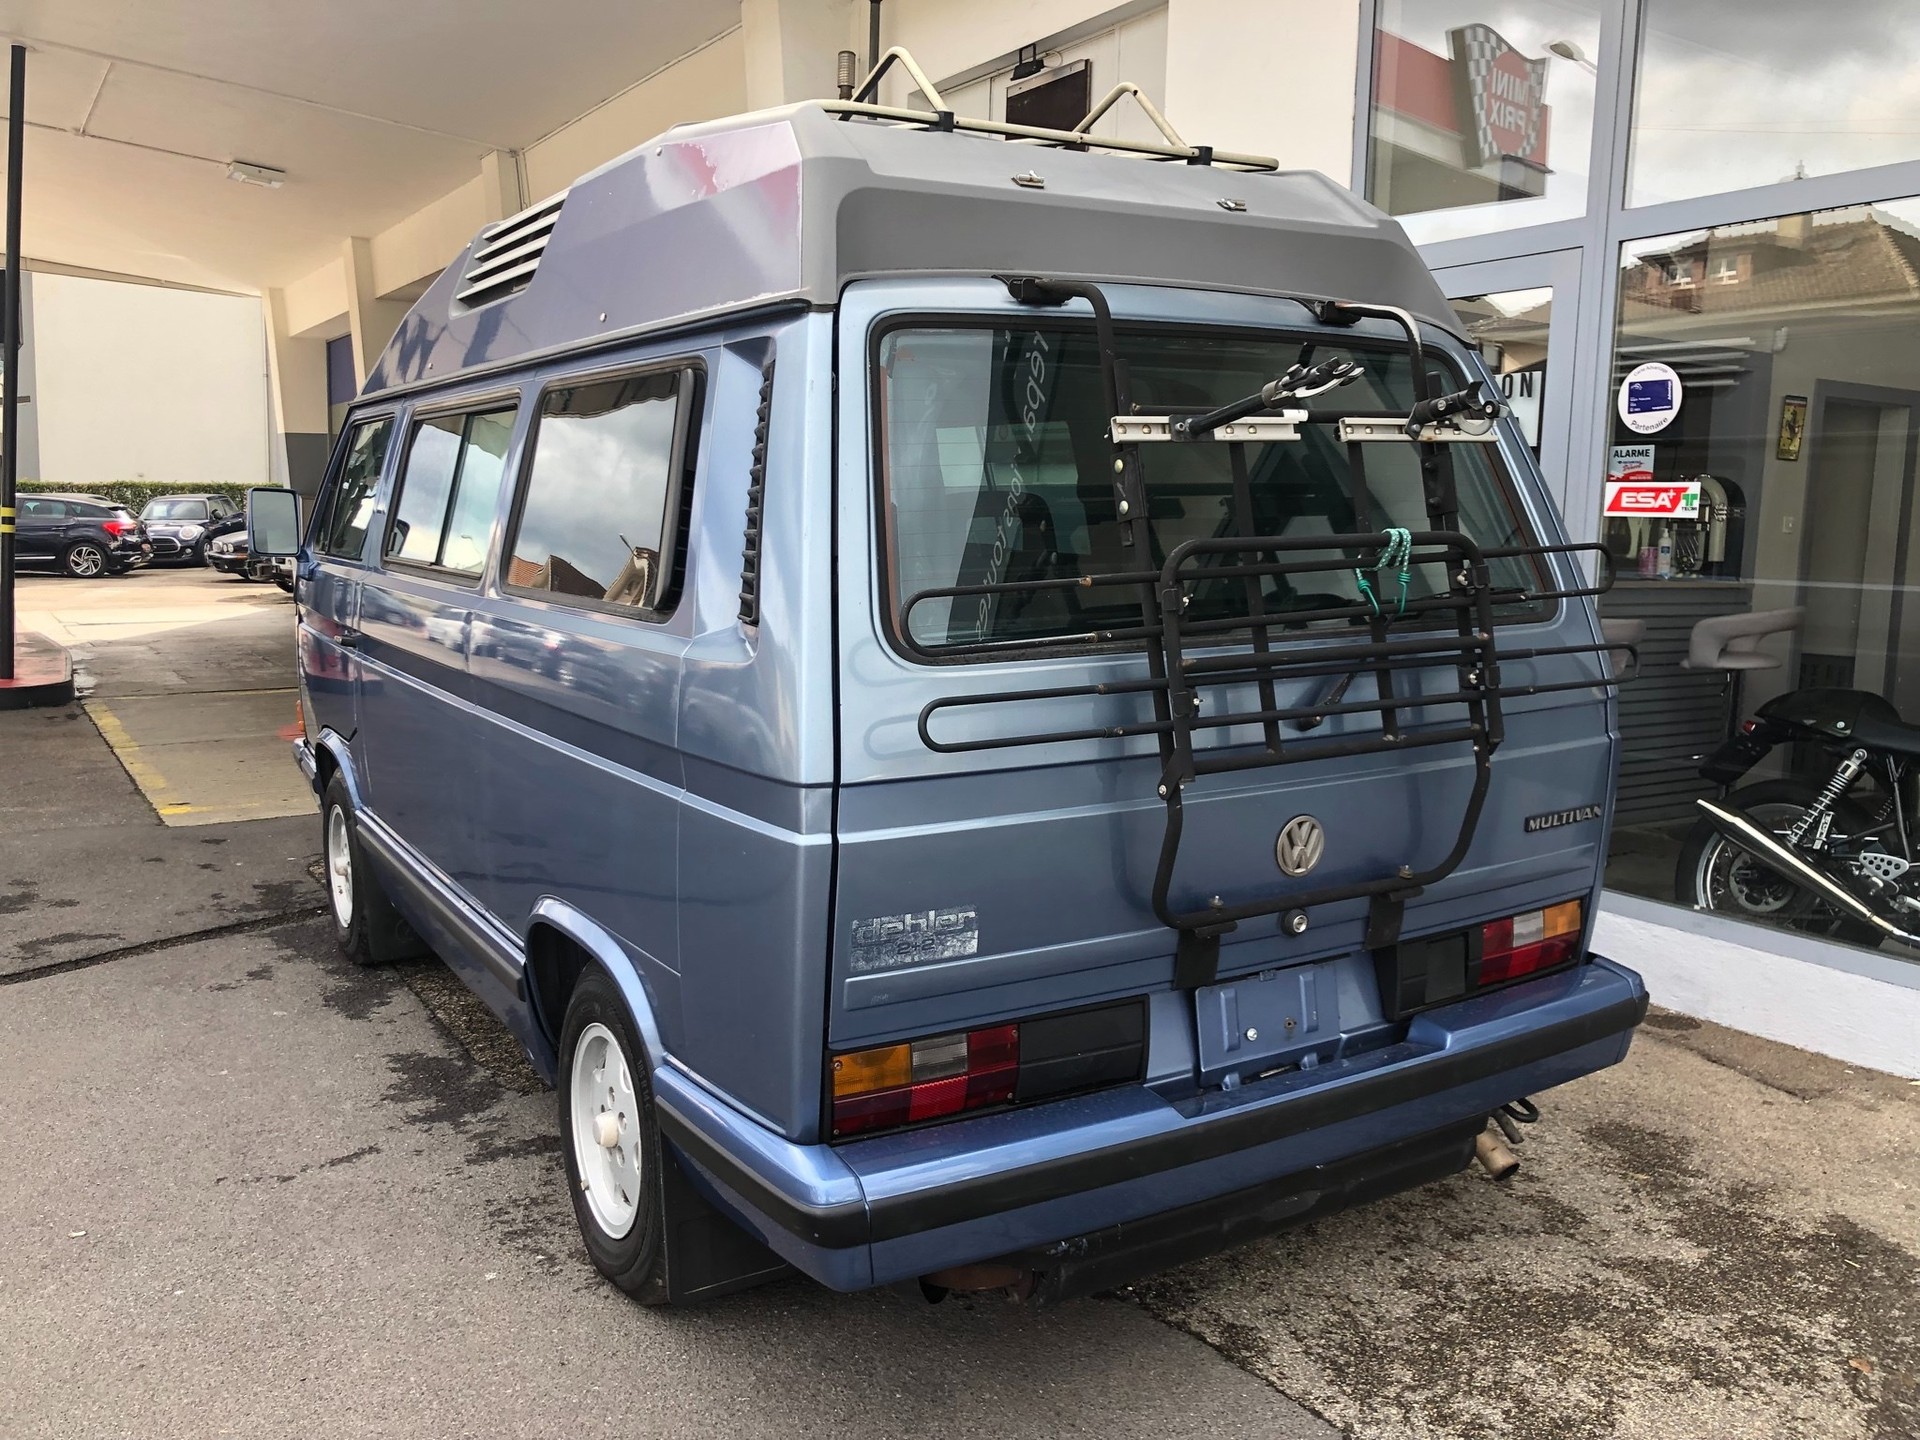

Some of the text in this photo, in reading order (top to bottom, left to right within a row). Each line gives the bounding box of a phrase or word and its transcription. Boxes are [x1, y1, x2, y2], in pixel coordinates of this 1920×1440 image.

[1497, 372, 1533, 399] ON
[1631, 417, 1668, 431] Partenaire
[1614, 449, 1650, 458] ALARME
[1528, 806, 1602, 831] MULTIVAN
[1278, 817, 1323, 876] VW
[855, 909, 976, 943] dehler
[896, 937, 936, 955] 2+2
